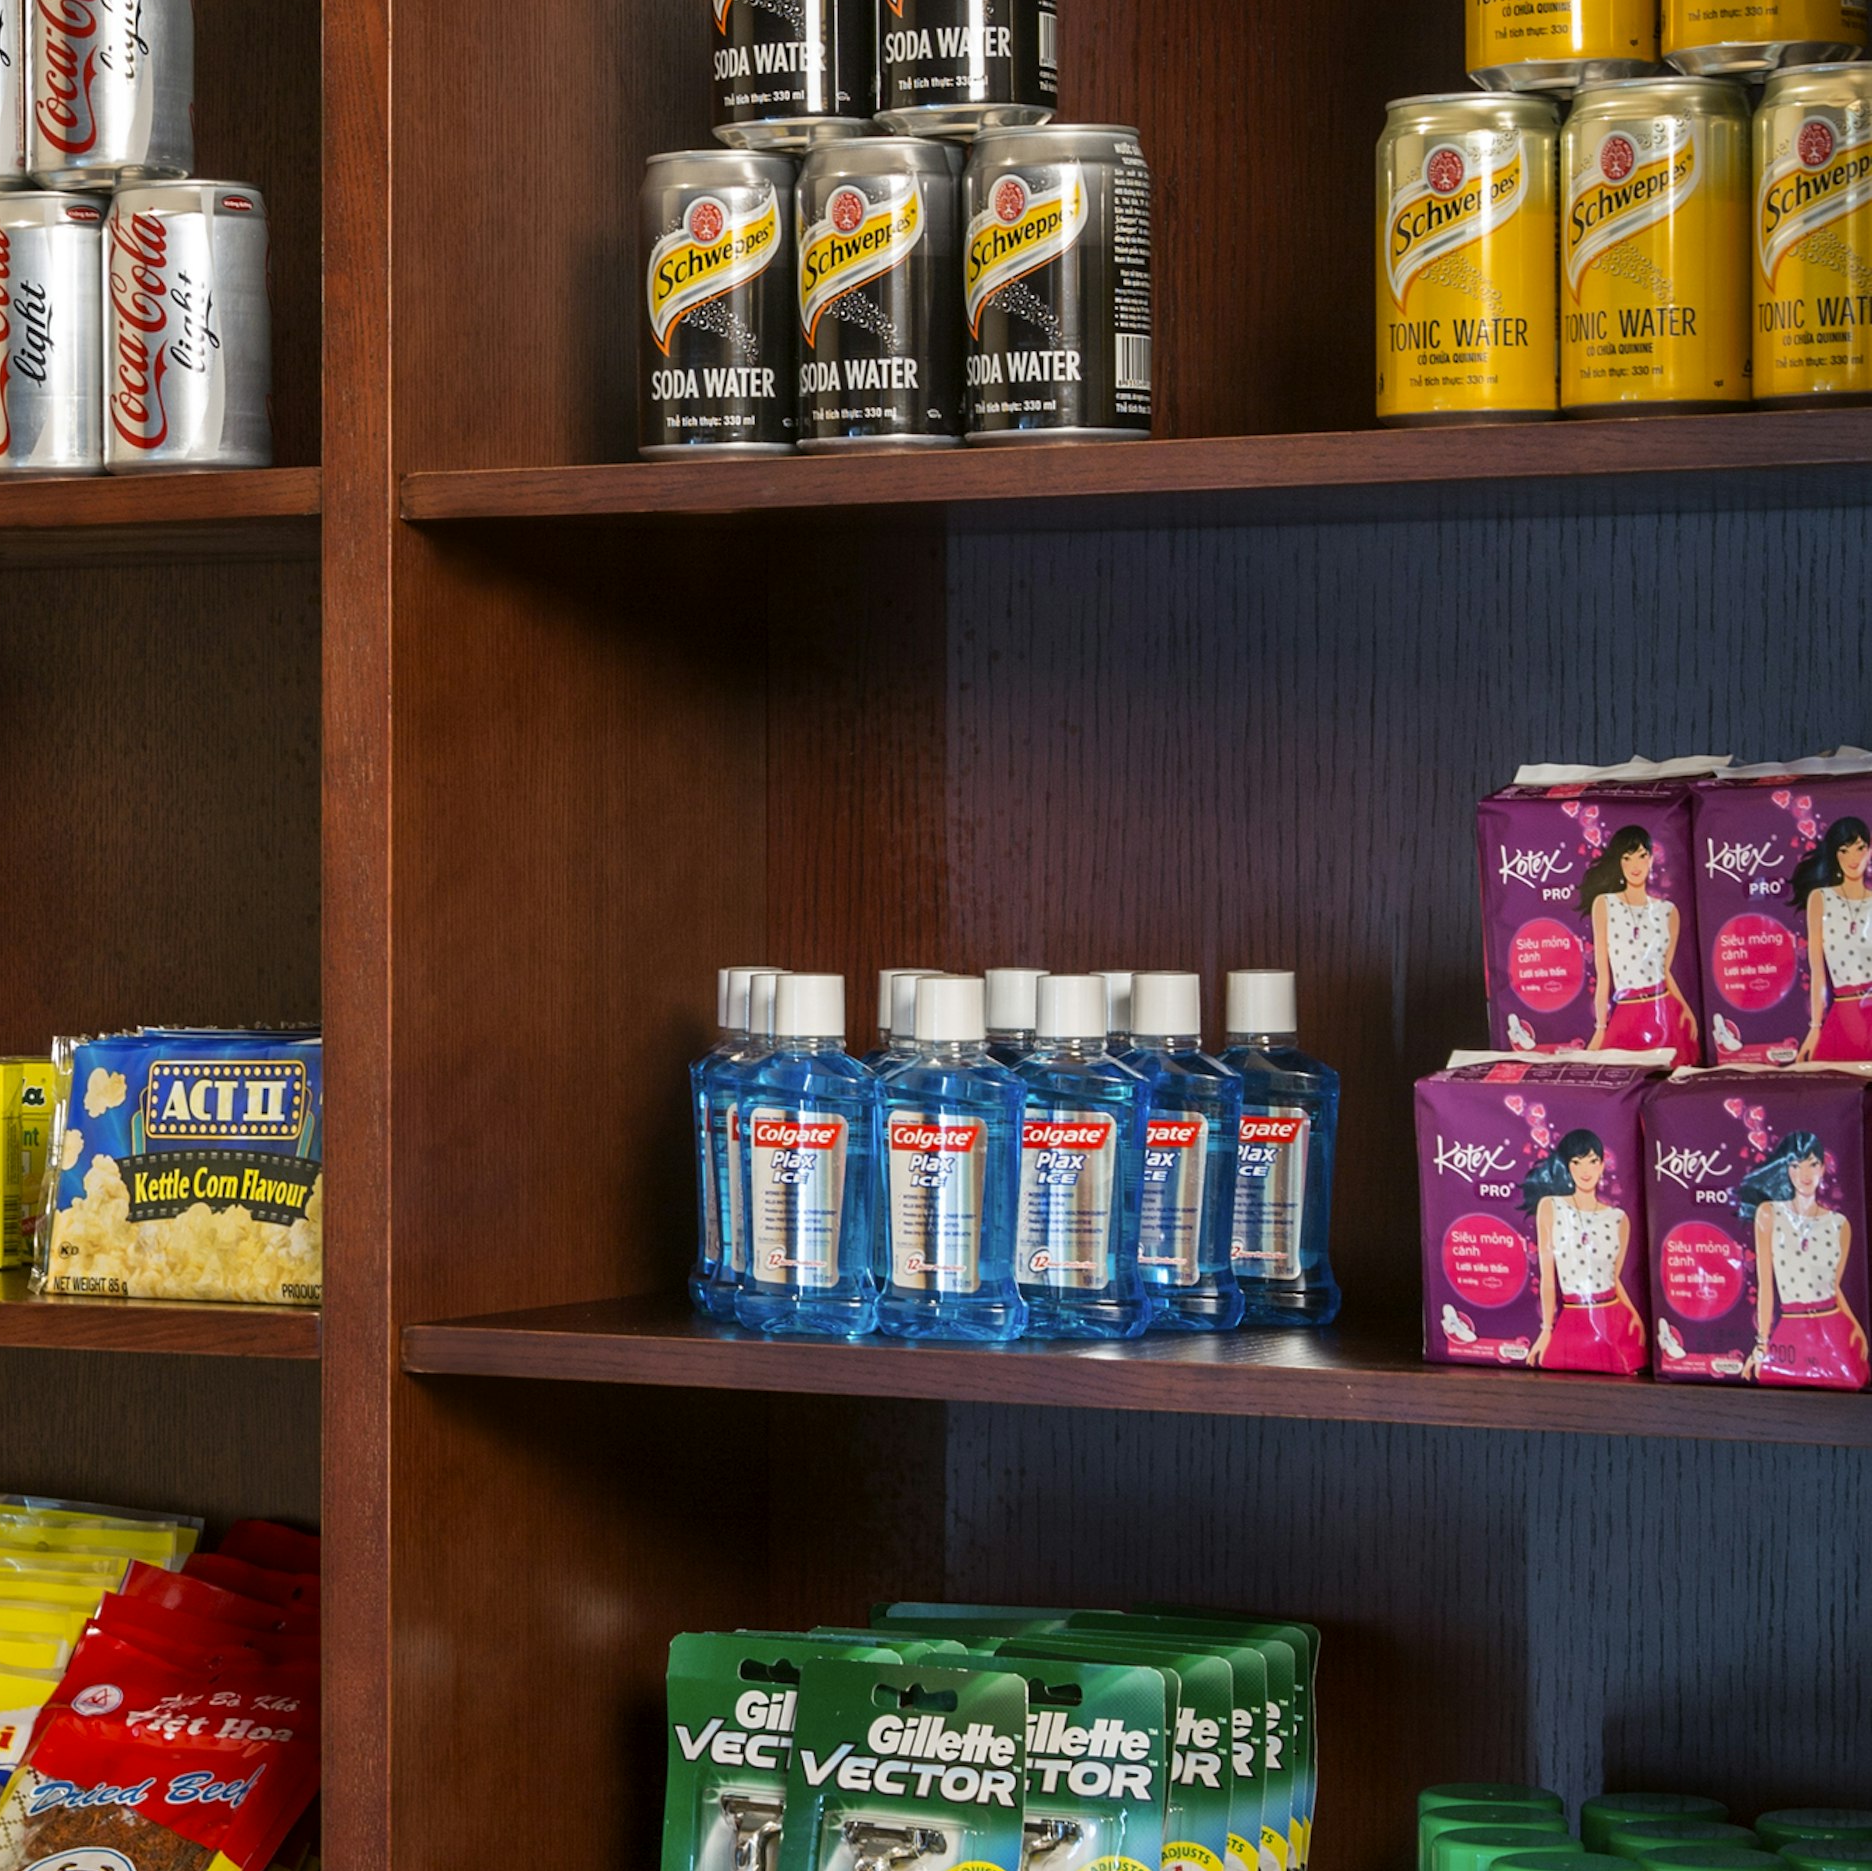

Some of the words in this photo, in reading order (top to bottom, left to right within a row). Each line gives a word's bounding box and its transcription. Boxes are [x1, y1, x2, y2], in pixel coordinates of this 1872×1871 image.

[1572, 160, 1686, 244] Schweppes
[658, 226, 769, 299] Schweppes
[804, 214, 912, 291] Schweppes
[12, 279, 54, 387] light
[1390, 321, 1441, 352] TONIC
[1453, 318, 1528, 348] WATER
[1565, 310, 1607, 342] TONIC
[1619, 307, 1696, 336] WATER
[652, 370, 698, 401] SODA
[703, 369, 776, 398] WATER
[967, 356, 1006, 385] SODA
[1011, 352, 1082, 381] WATER
[723, 416, 742, 428] 330
[1499, 845, 1572, 888] Kotex
[1705, 838, 1784, 884] Kotex
[1543, 888, 1571, 900] PRO
[1749, 882, 1781, 895] PRO
[162, 1080, 238, 1121] ACT
[243, 1080, 287, 1121] II
[757, 1124, 832, 1145] Colgate
[894, 1125, 969, 1147] Colgate
[1023, 1124, 1099, 1143] Colgate
[772, 1151, 816, 1169] Plax
[1036, 1152, 1083, 1171] Plax
[1434, 1136, 1515, 1182] Kotex
[135, 1169, 190, 1203] Kettle
[194, 1167, 237, 1200] Corn
[241, 1170, 307, 1208] Flavour
[1039, 1173, 1076, 1186] ICE
[54, 1276, 70, 1291] NET
[73, 1277, 105, 1292] WEIGHT
[109, 1278, 120, 1292] 85
[282, 1283, 321, 1299] PRODUC
[215, 1719, 293, 1742] Hoa
[868, 1714, 1017, 1763] Gillette
[28, 1778, 156, 1816] Dried
[165, 1764, 266, 1809] Beef
[800, 1744, 1016, 1806] VECTOR
